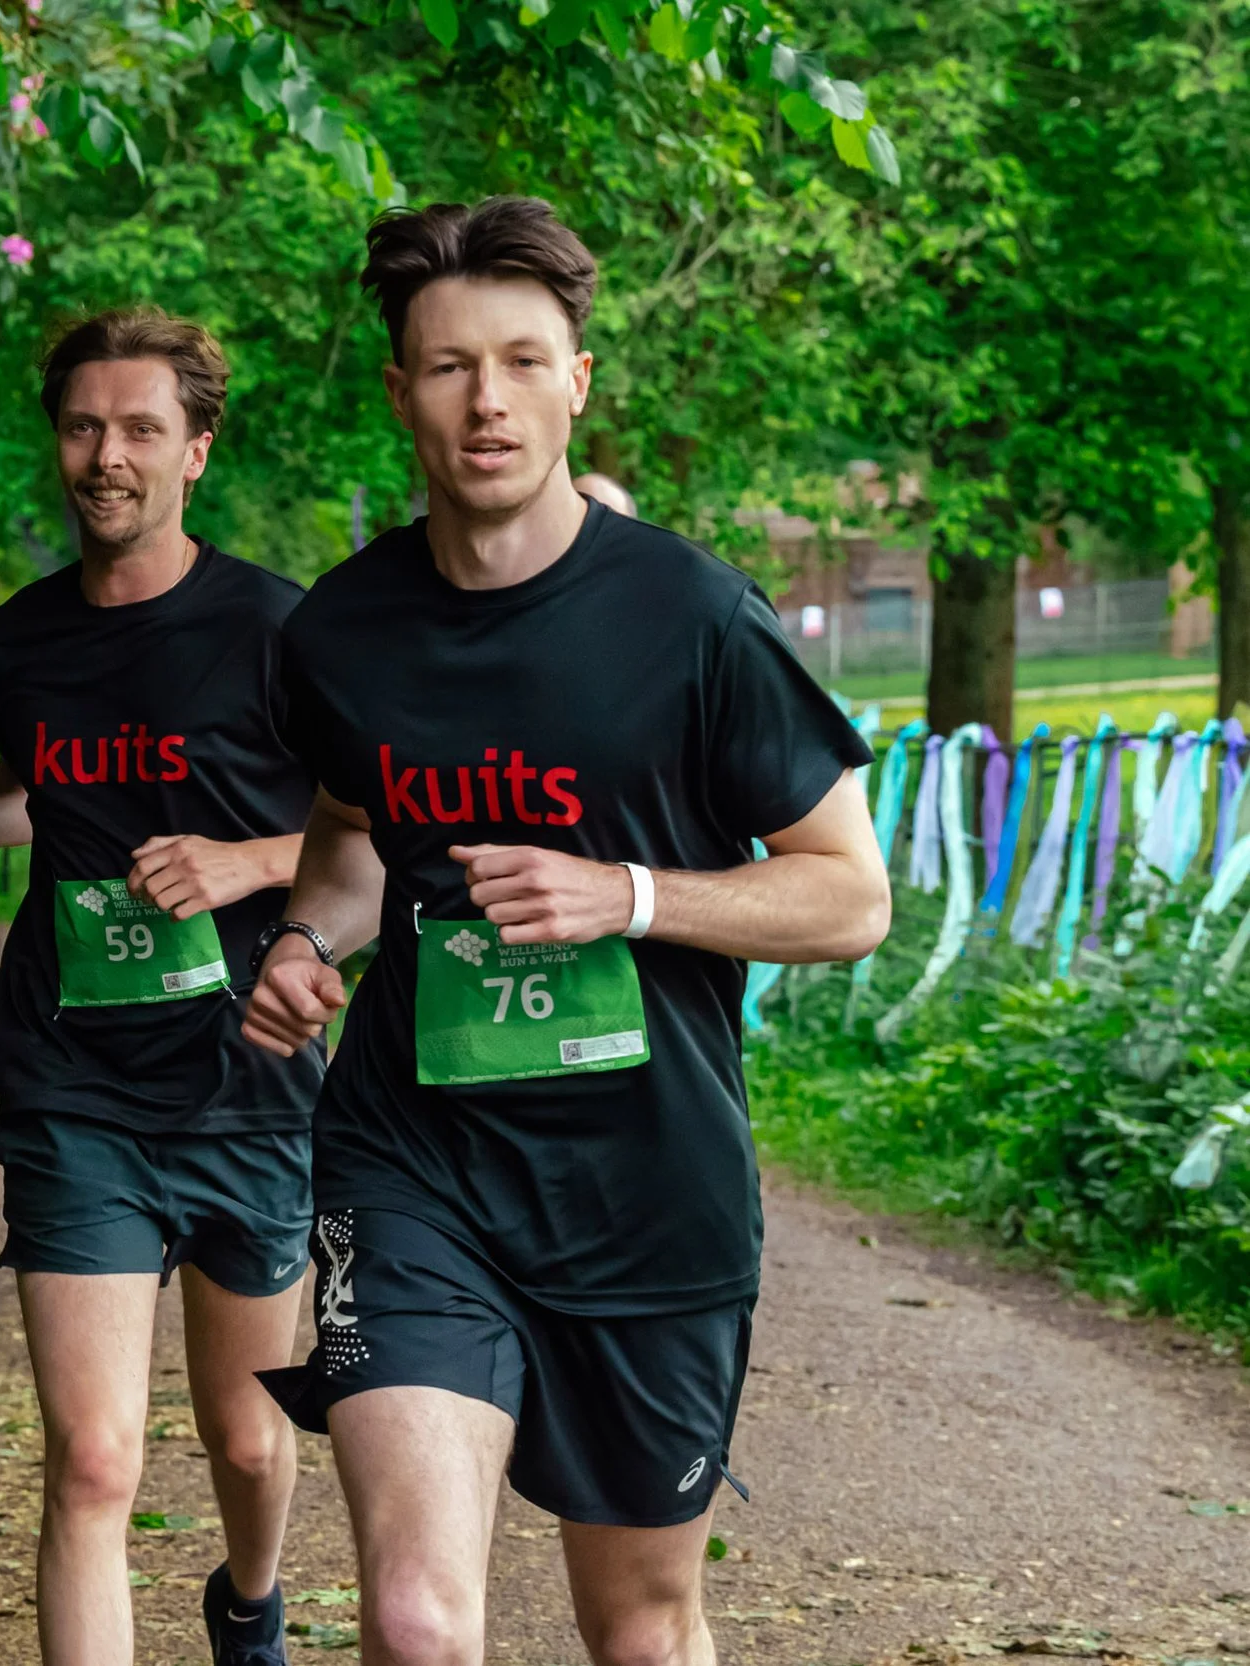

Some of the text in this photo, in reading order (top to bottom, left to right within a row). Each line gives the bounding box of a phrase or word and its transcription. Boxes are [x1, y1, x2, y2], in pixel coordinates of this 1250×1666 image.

[34, 722, 188, 785] kuits
[378, 744, 583, 826] kuits
[105, 924, 154, 961] 59
[499, 951, 579, 968] RUN & WALK
[483, 973, 554, 1023] 76
